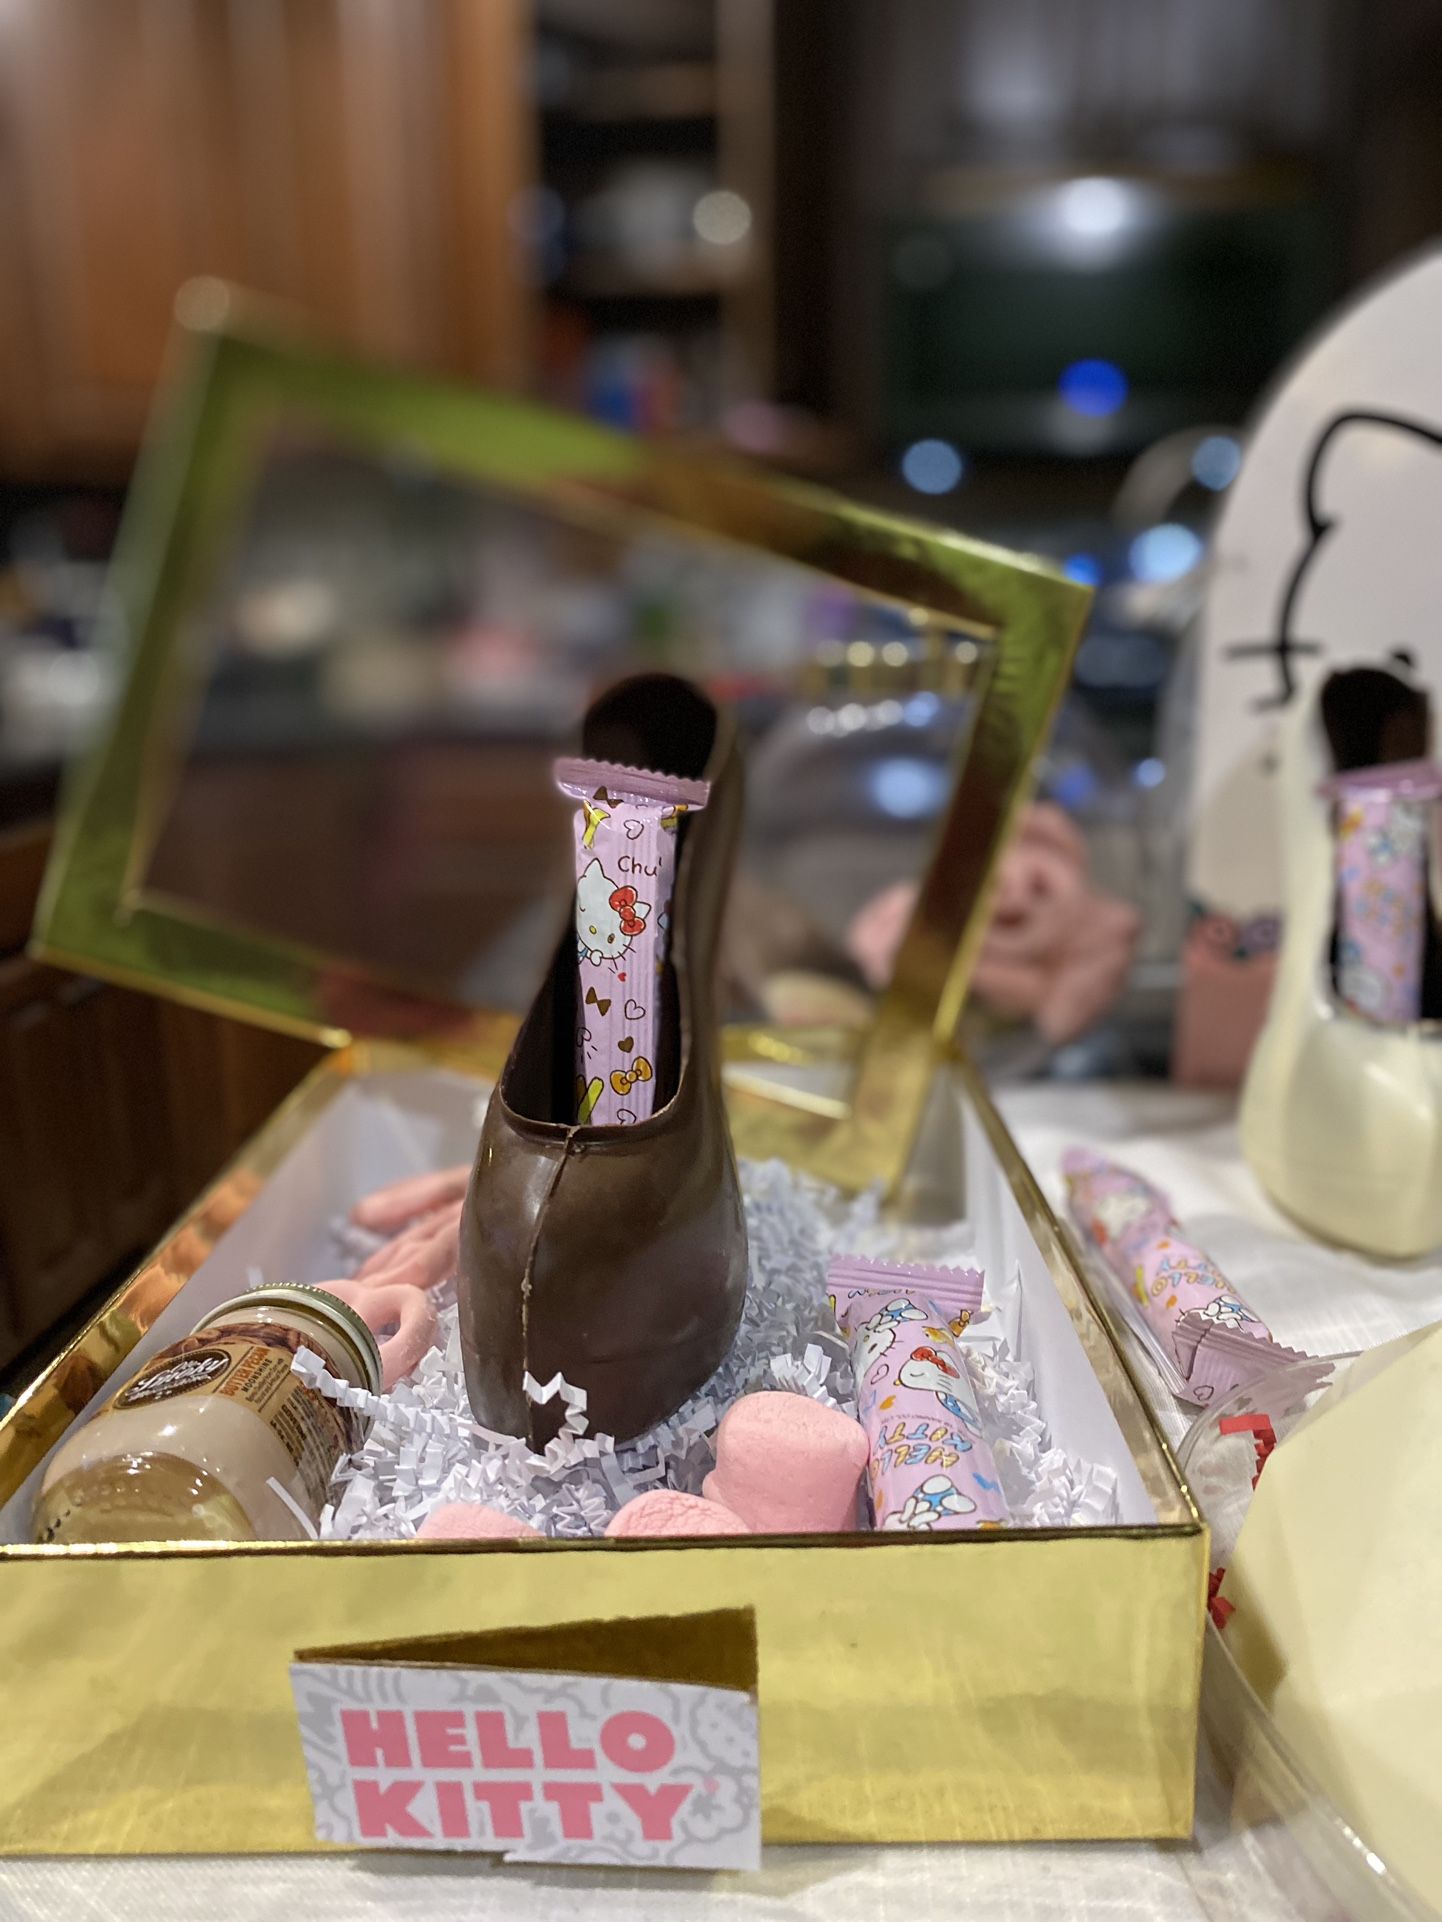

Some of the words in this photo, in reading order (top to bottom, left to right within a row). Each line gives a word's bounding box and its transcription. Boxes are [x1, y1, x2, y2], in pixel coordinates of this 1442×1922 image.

[219, 1366, 251, 1397] BUTTER
[240, 1358, 273, 1392] MOONSHINE
[873, 1422, 973, 1456] KITTY
[870, 1443, 960, 1480] HELLO
[339, 1709, 677, 1773] HELLO
[352, 1778, 695, 1841] KITTY
